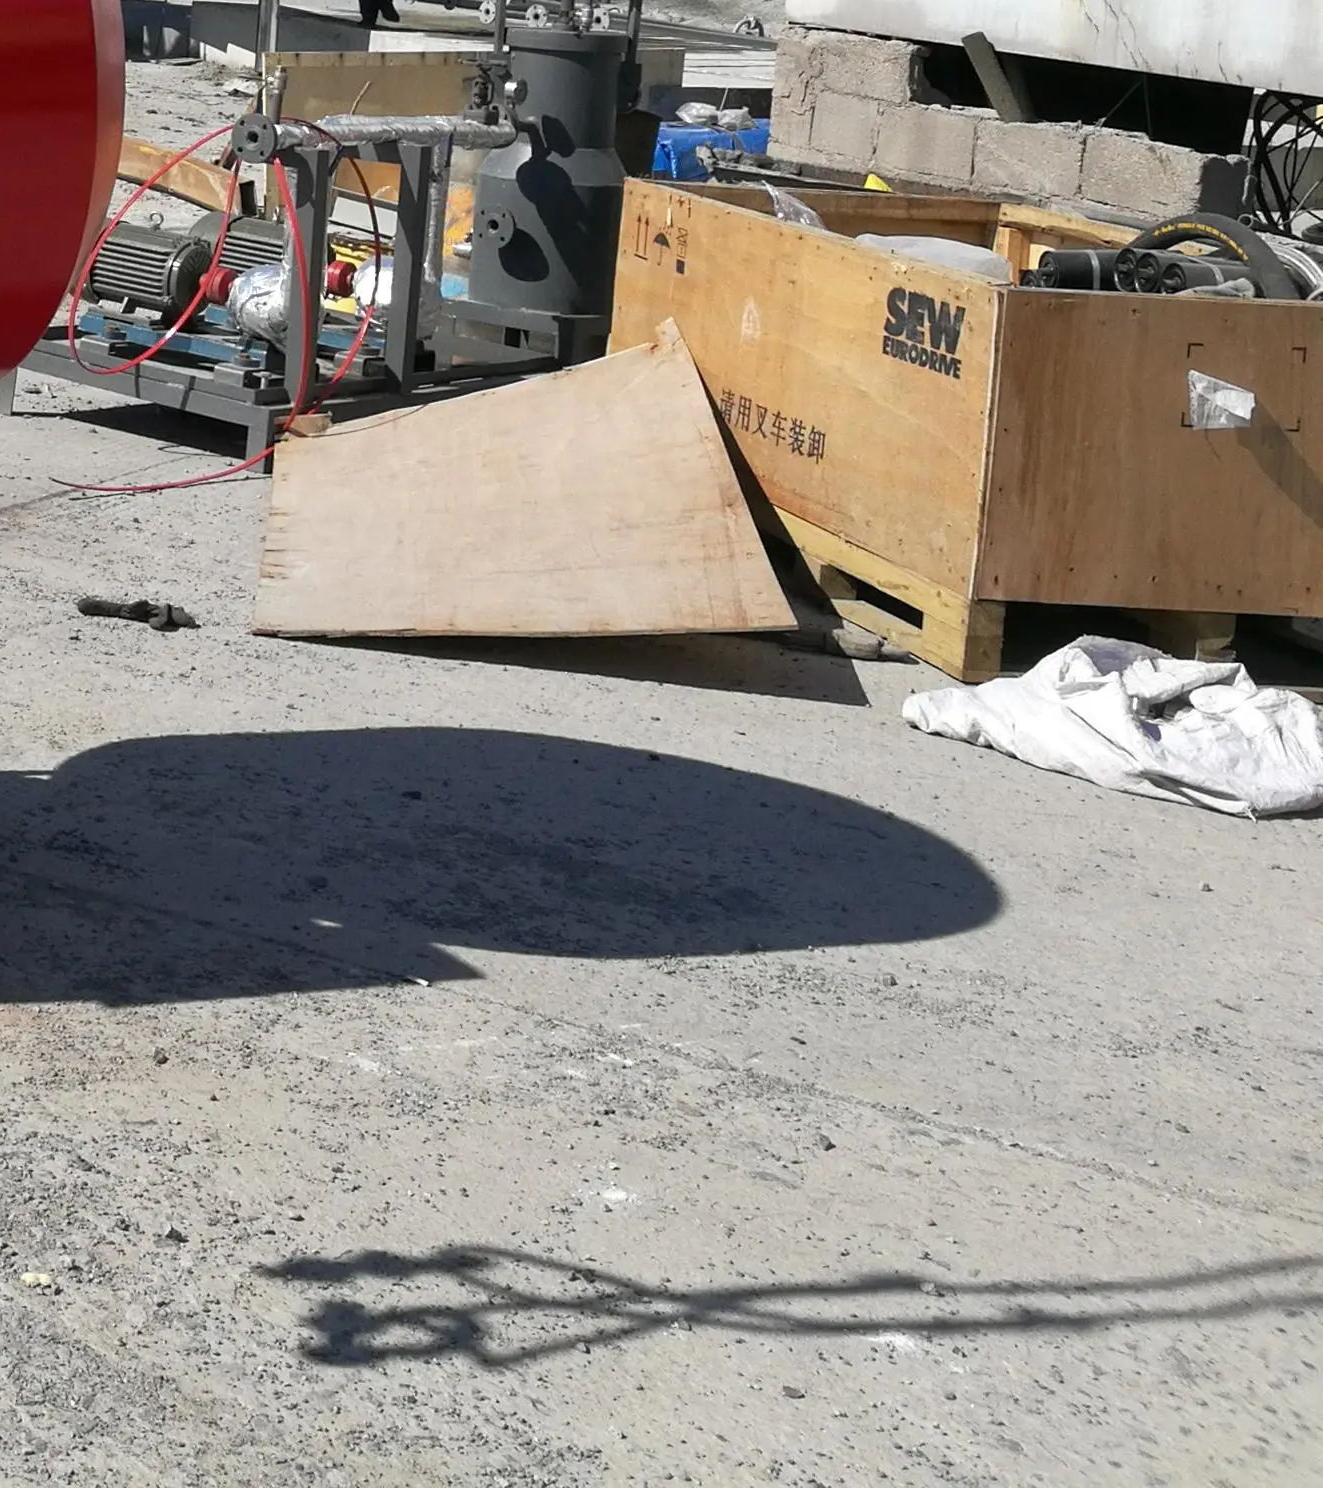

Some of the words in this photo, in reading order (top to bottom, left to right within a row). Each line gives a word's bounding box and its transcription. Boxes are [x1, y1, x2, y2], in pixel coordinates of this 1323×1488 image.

[883, 286, 966, 355] SEW
[882, 335, 962, 380] EURODRIVE
[719, 389, 826, 465] 请用叉车装卸
